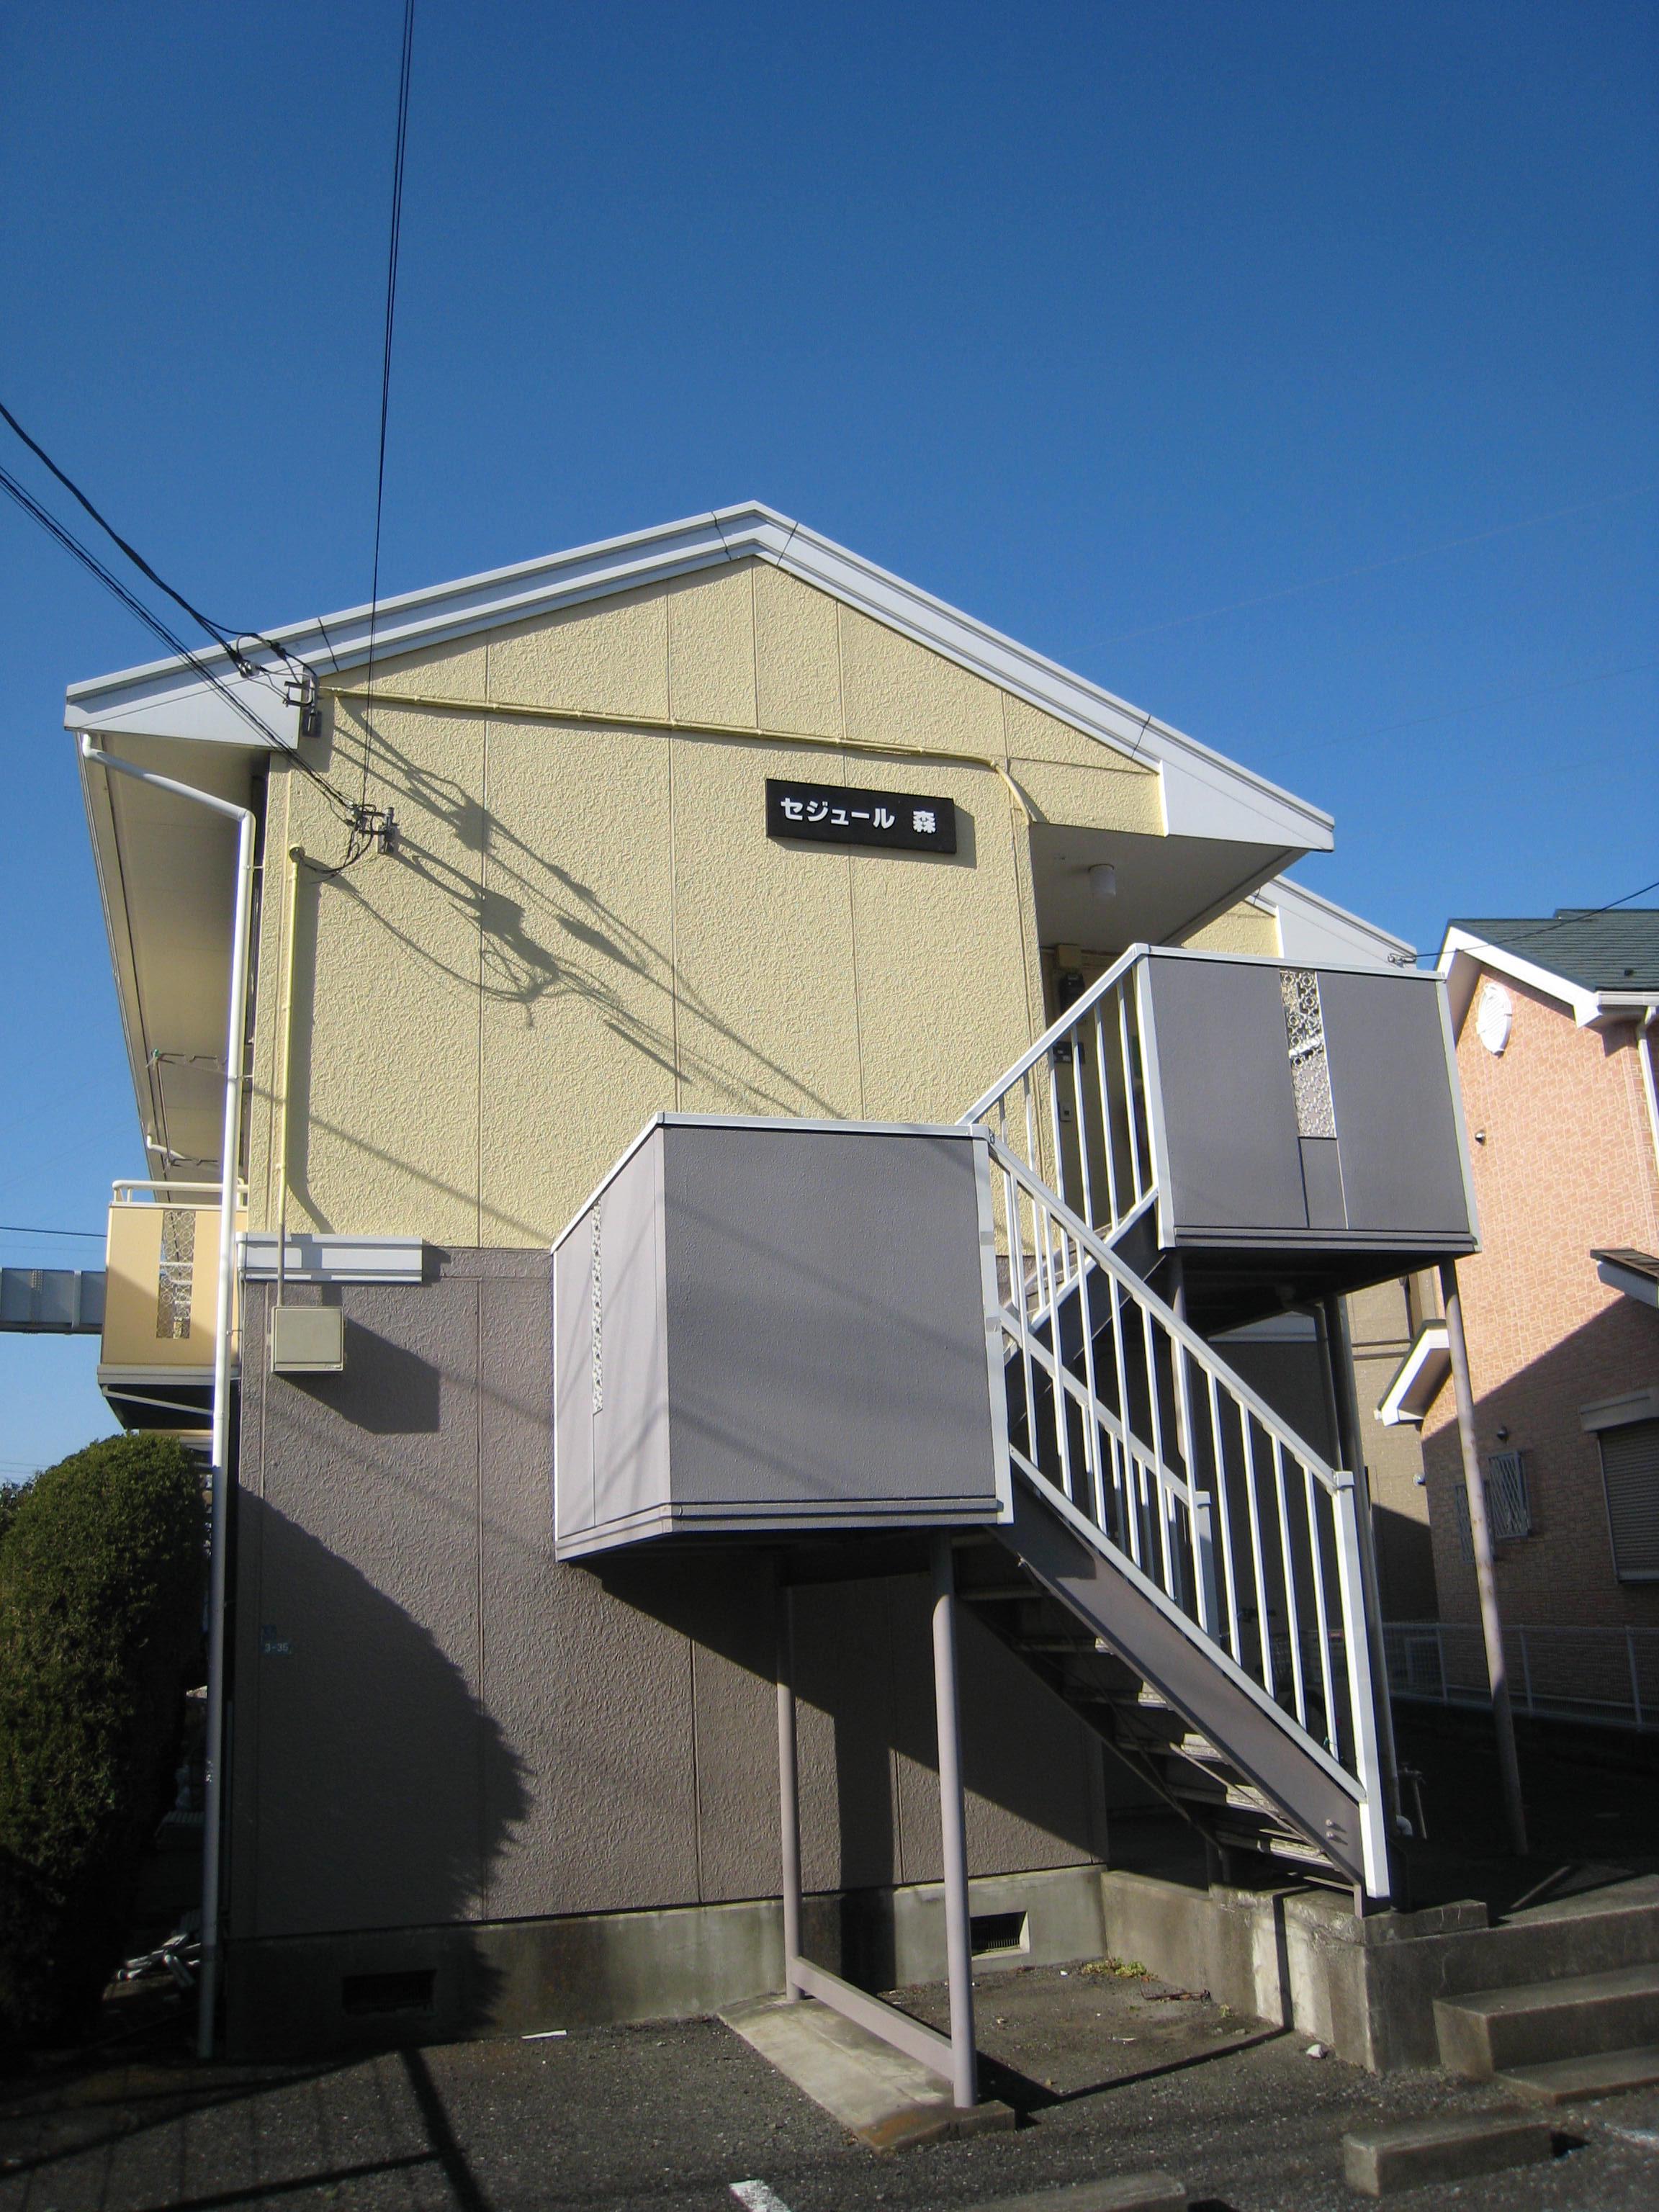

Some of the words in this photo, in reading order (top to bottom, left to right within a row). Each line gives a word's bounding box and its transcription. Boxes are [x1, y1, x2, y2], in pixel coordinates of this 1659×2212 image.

[781, 798, 895, 829] セジュール
[912, 811, 936, 834] 森
